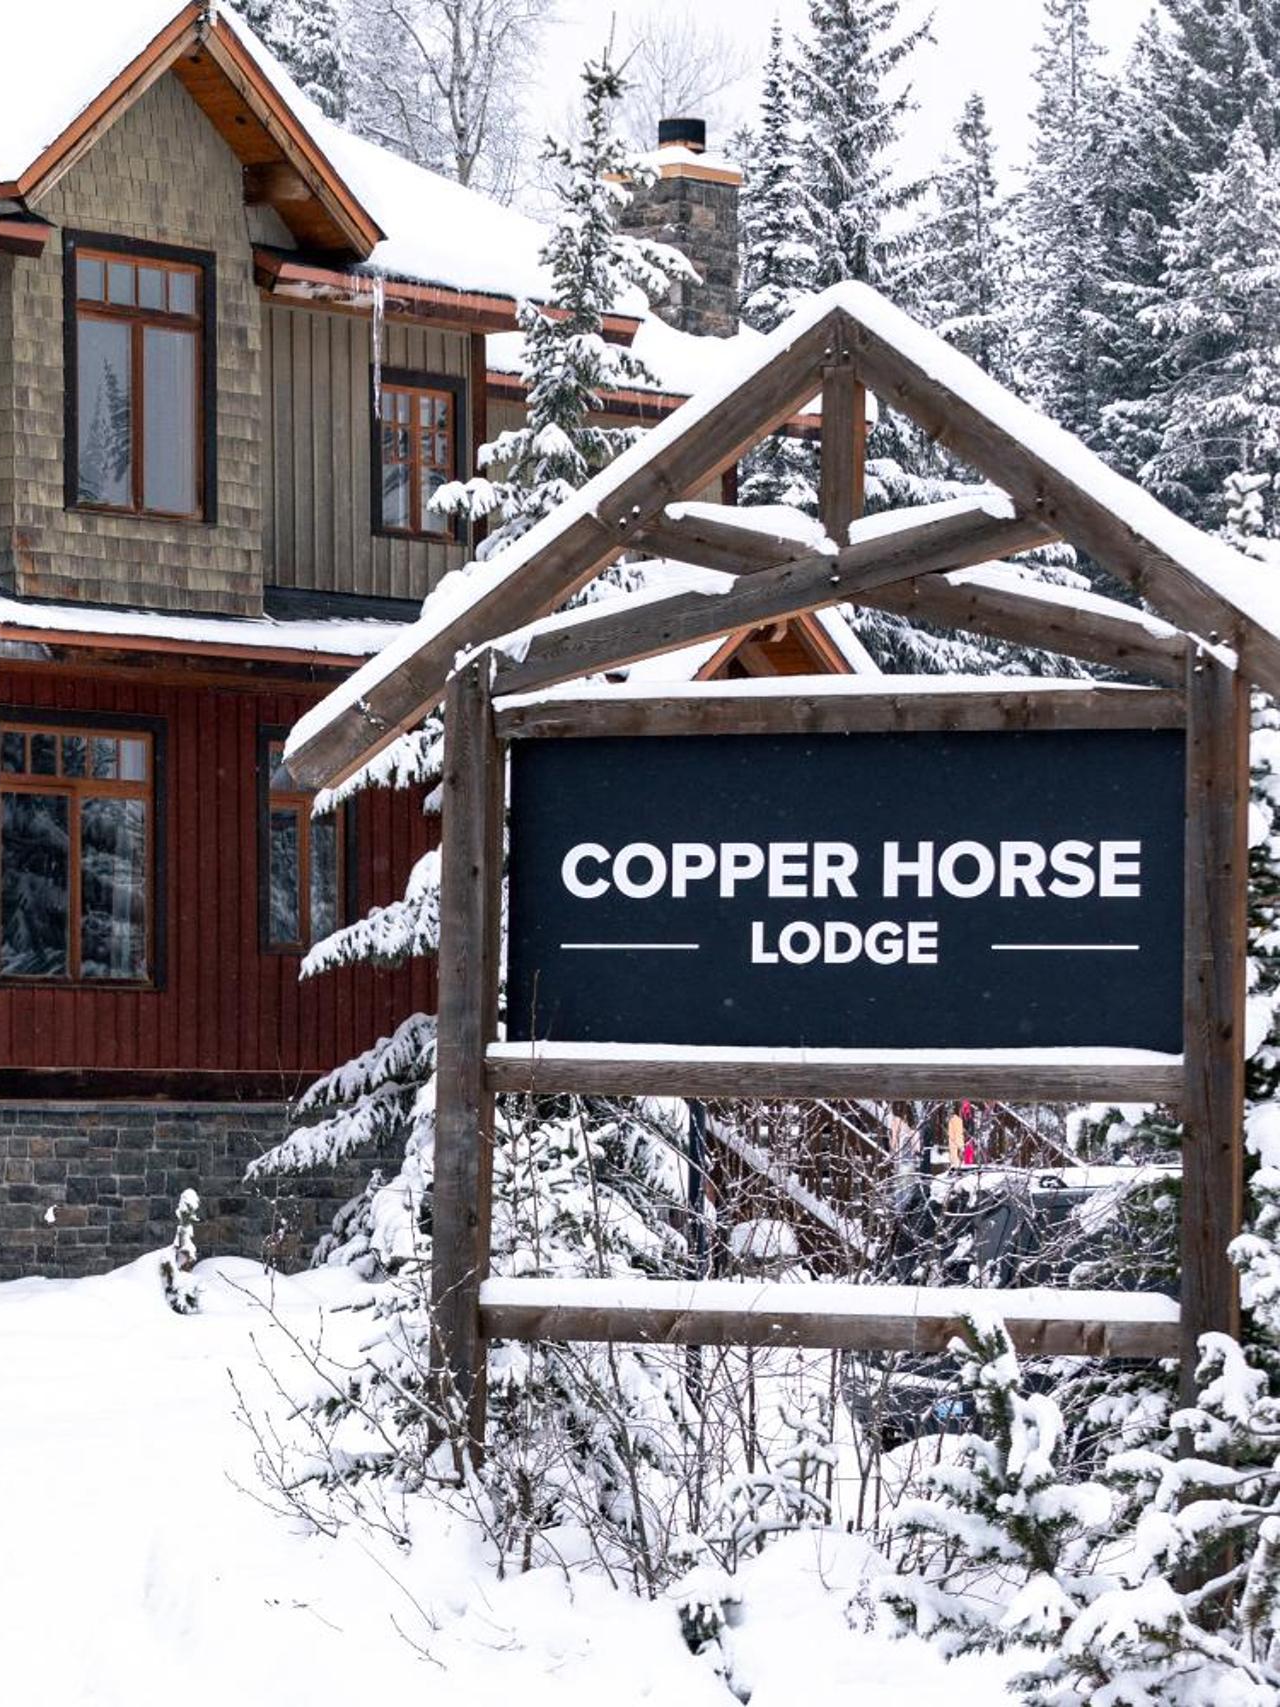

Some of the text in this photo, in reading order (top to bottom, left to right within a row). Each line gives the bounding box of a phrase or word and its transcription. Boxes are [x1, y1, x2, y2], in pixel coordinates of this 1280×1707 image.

[561, 839, 1141, 899] COPPER HORSE
[751, 920, 938, 965] LODGE
